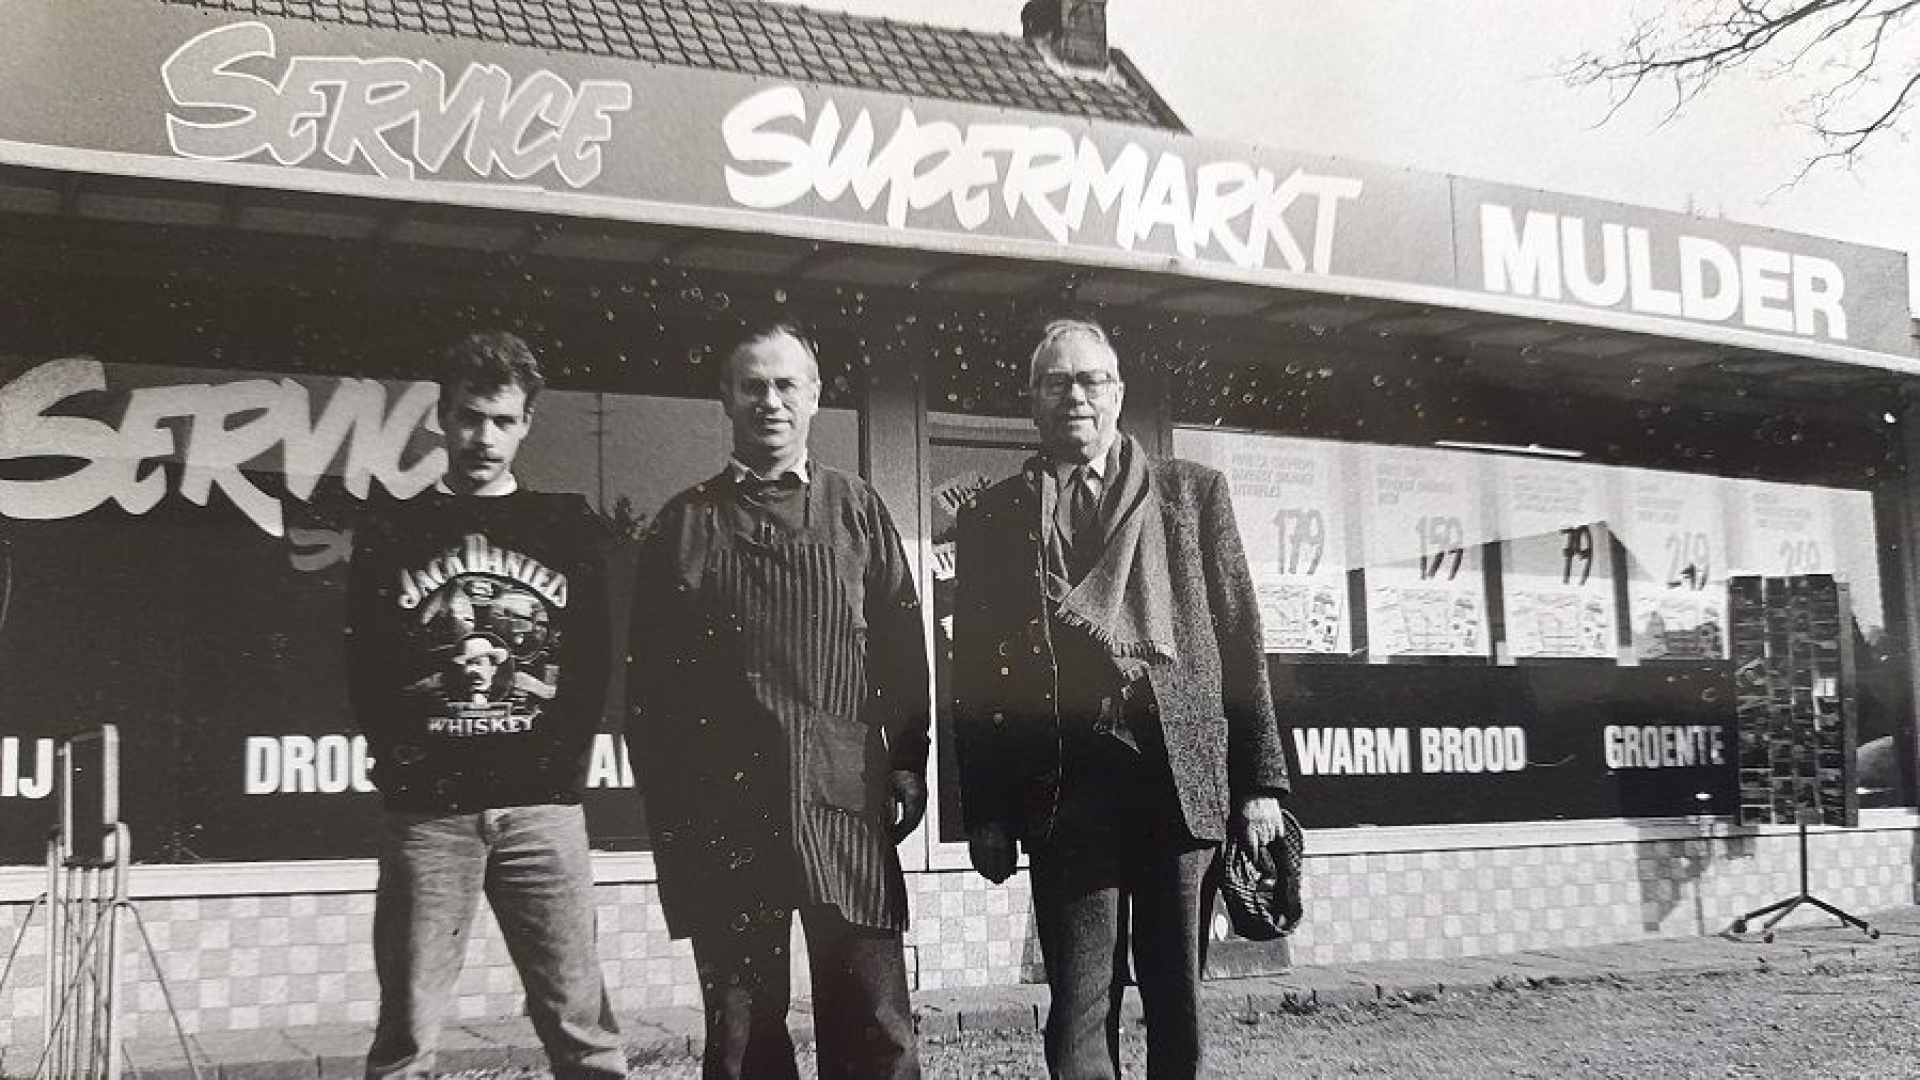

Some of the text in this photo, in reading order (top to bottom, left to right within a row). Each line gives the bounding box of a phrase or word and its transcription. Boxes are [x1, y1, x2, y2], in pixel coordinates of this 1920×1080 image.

[161, 20, 1364, 275] SERVICE SUPERMARKT
[1480, 203, 1848, 341] MULDER
[0, 357, 449, 536] SERVIC
[427, 716, 533, 736] WHISKEY
[1293, 726, 1527, 776] WARM BROOD
[1604, 724, 1726, 771] GROENTE
